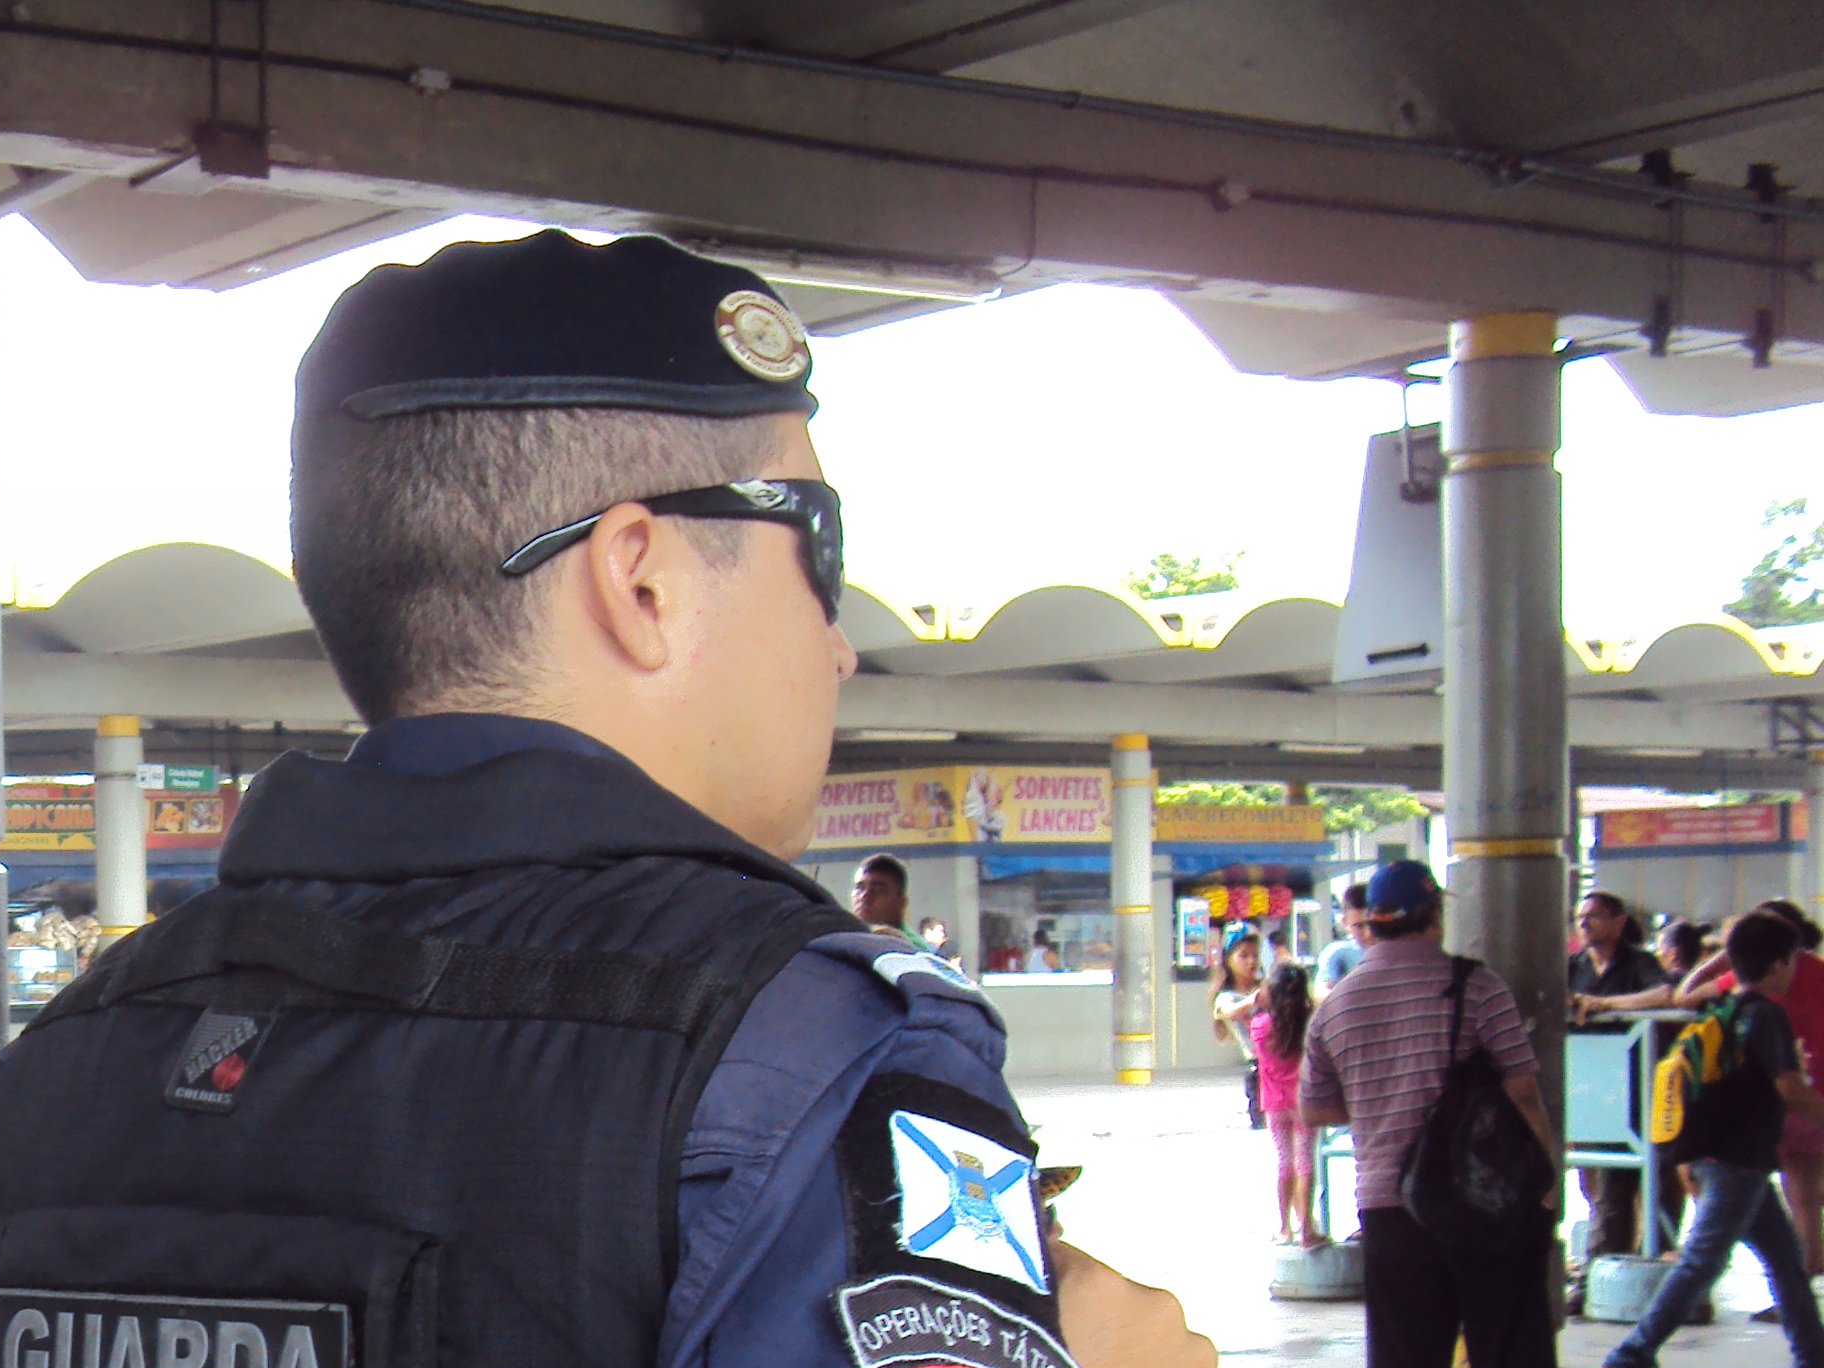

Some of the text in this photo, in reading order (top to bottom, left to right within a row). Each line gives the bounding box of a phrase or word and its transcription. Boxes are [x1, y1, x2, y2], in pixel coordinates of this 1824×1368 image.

[818, 779, 897, 807] ORVETES
[1014, 775, 1101, 800] SORVETES
[816, 811, 891, 838] LANCHES
[1020, 808, 1096, 832] LANCHES
[856, 1299, 993, 1351] OPERAÇÕES
